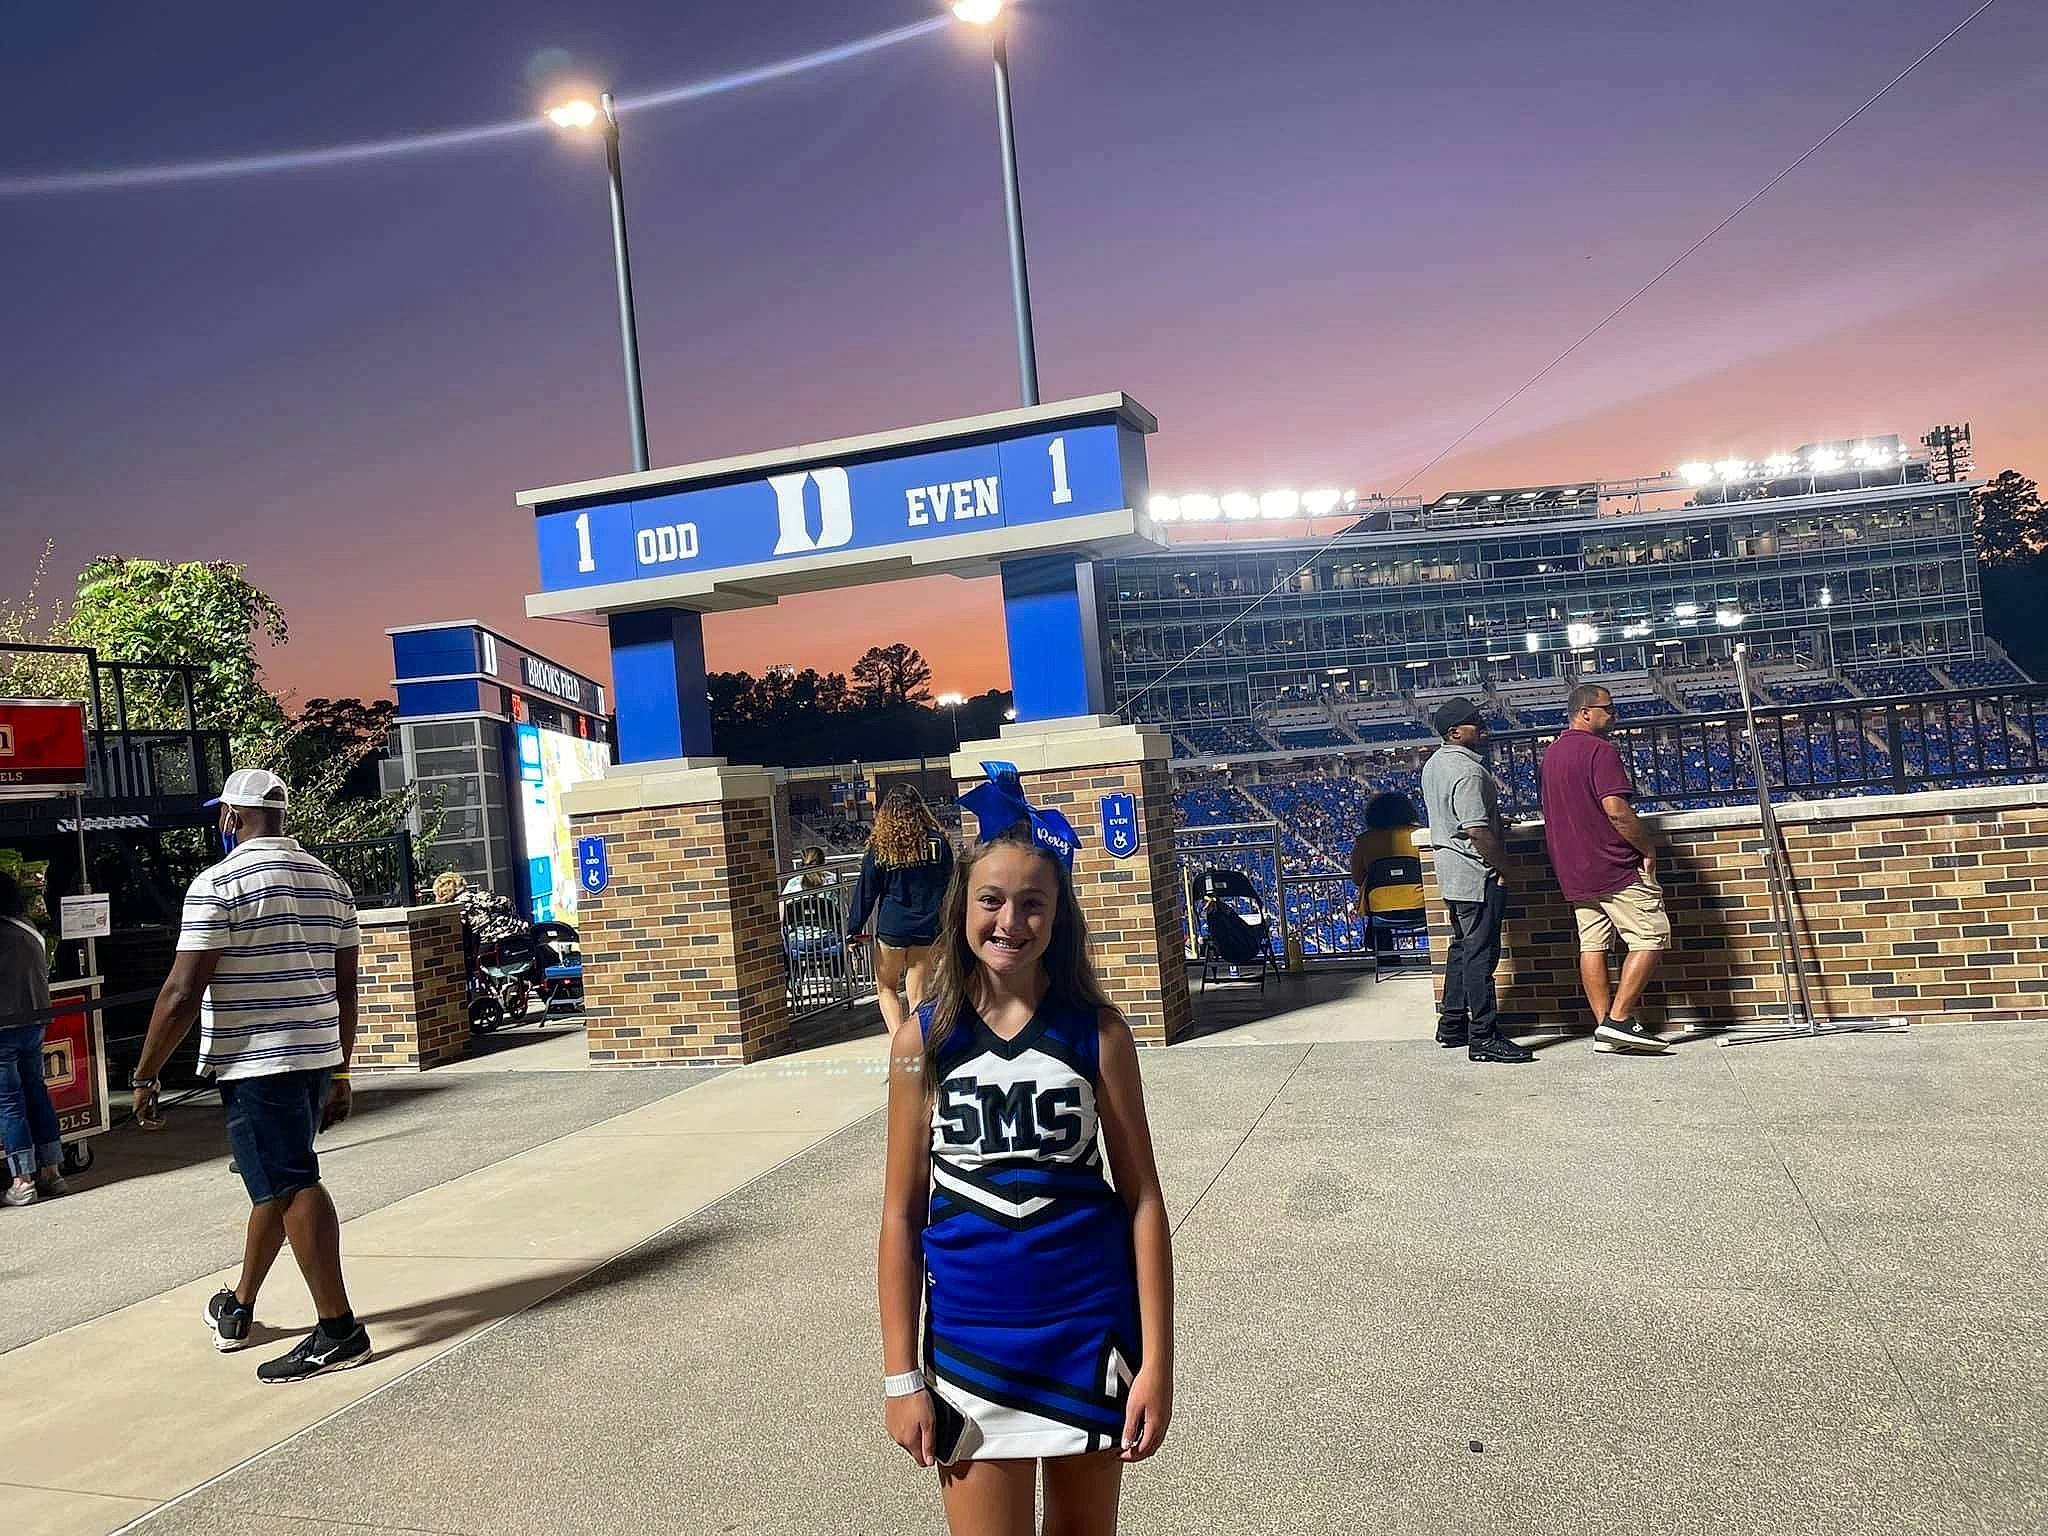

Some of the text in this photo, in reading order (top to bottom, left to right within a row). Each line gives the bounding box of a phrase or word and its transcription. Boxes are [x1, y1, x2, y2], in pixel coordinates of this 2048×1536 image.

[575, 437, 1073, 573] 1 ODD D EVEN 1
[527, 657, 561, 696] BROOKS
[560, 672, 580, 703] FIELD
[0, 771, 23, 782] ELS
[1109, 817, 1128, 826] EVEN
[1036, 827, 1070, 855] Roxy
[59, 1111, 92, 1130] ELS
[939, 1076, 1082, 1157] SMS
